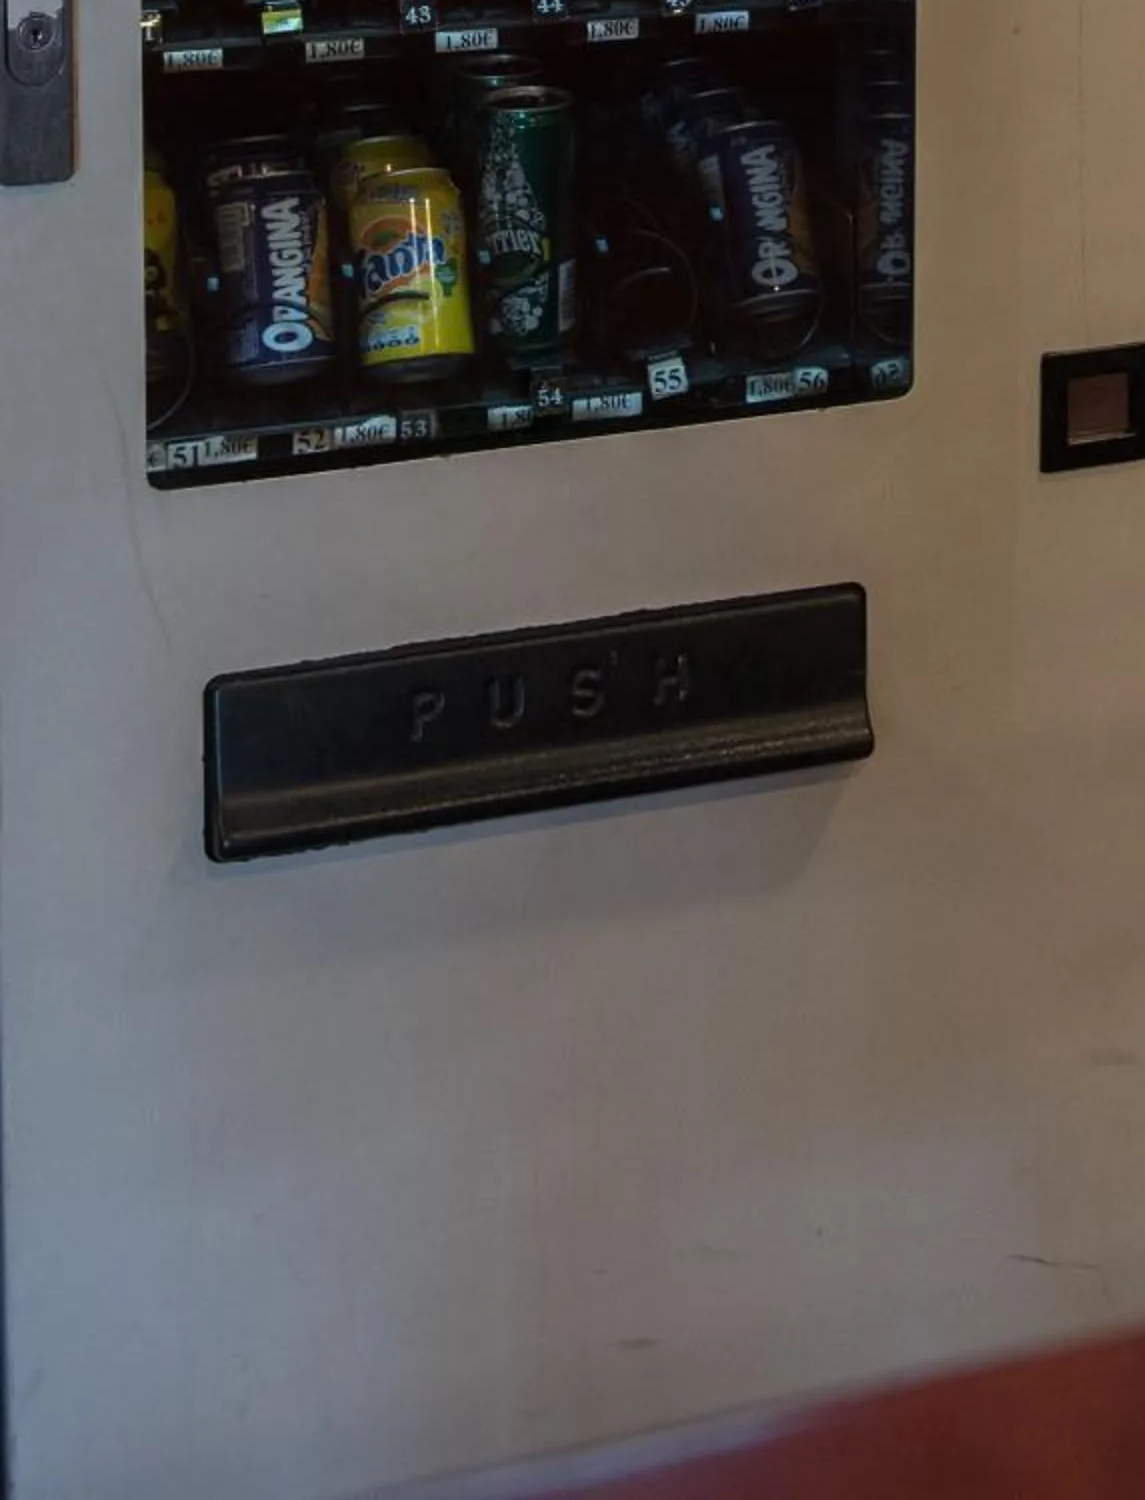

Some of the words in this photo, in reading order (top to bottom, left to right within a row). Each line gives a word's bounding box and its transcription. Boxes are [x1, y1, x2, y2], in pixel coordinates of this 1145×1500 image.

[404, 4, 432, 23] 43
[740, 144, 798, 286] ORNGINA
[654, 369, 683, 393] 55
[799, 370, 826, 389] 56
[537, 387, 563, 407] 54
[400, 419, 428, 438] 53
[295, 431, 326, 453] 52
[171, 443, 199, 468] 51
[410, 652, 690, 744] PUSH
